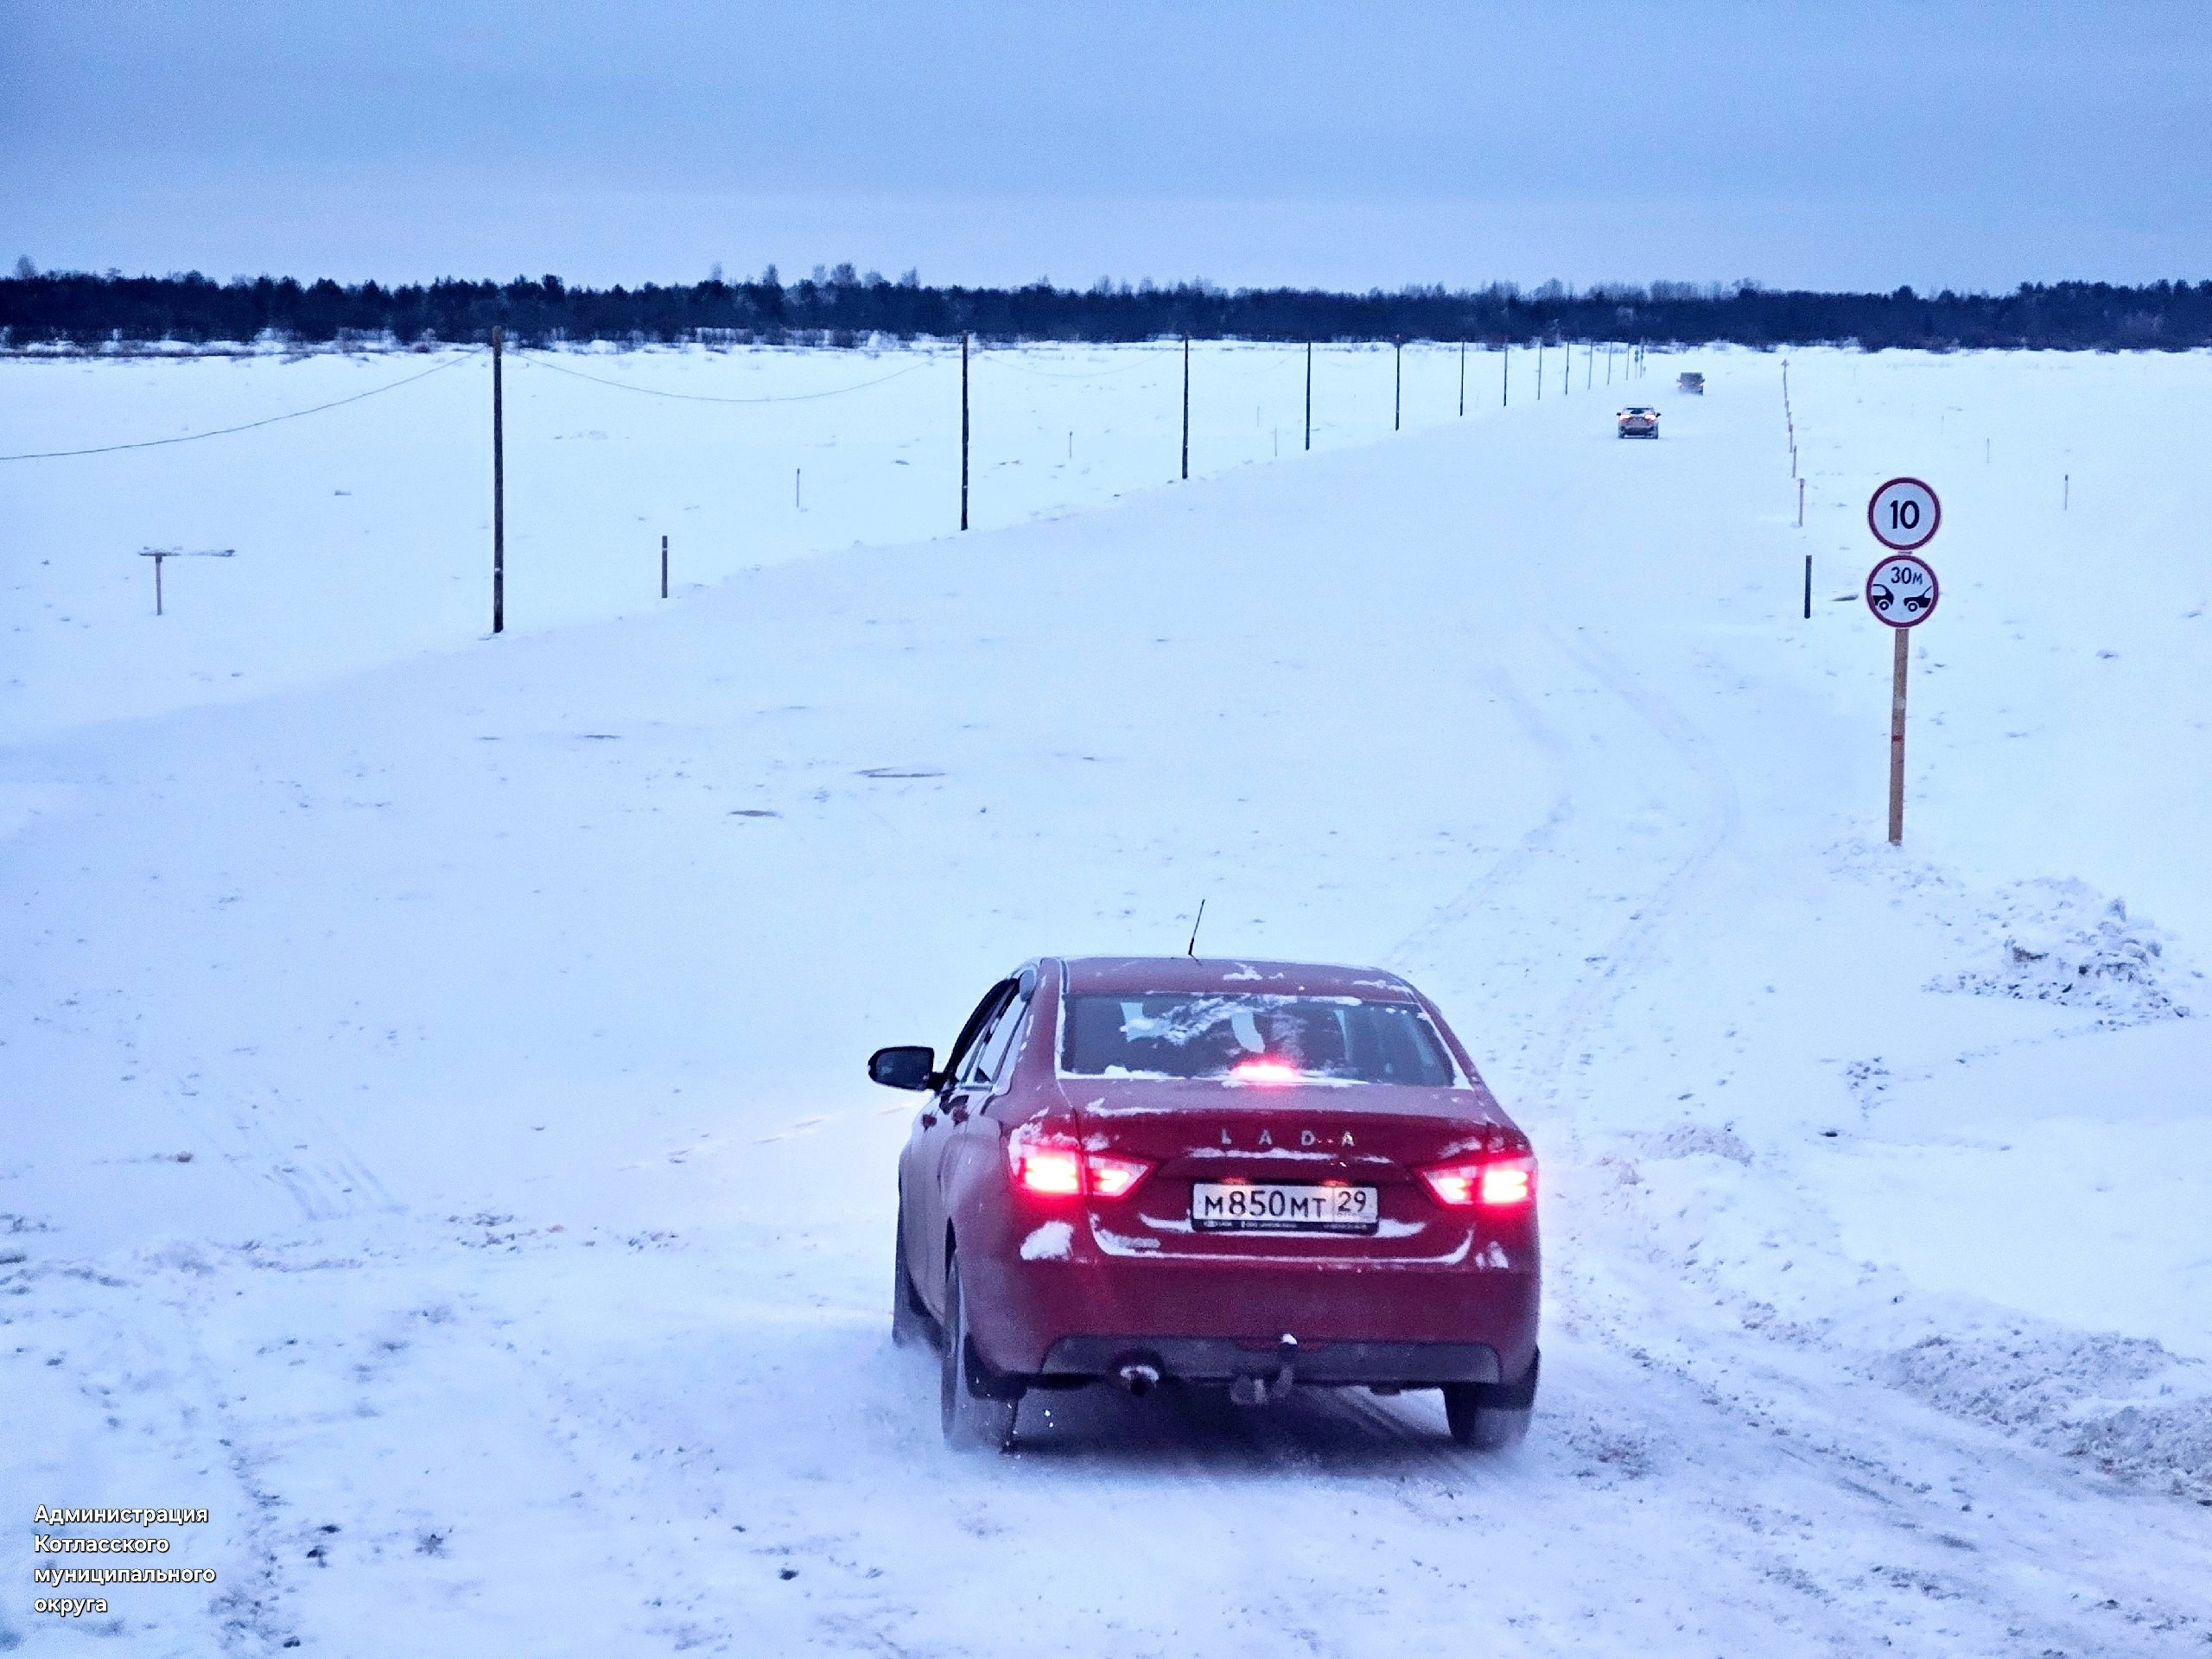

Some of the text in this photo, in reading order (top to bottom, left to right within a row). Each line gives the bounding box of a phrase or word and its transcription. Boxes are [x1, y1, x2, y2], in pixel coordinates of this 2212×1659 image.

[1890, 499, 1920, 529] 10
[1220, 1128, 1355, 1147] LADA
[1337, 1191, 1367, 1212] 29
